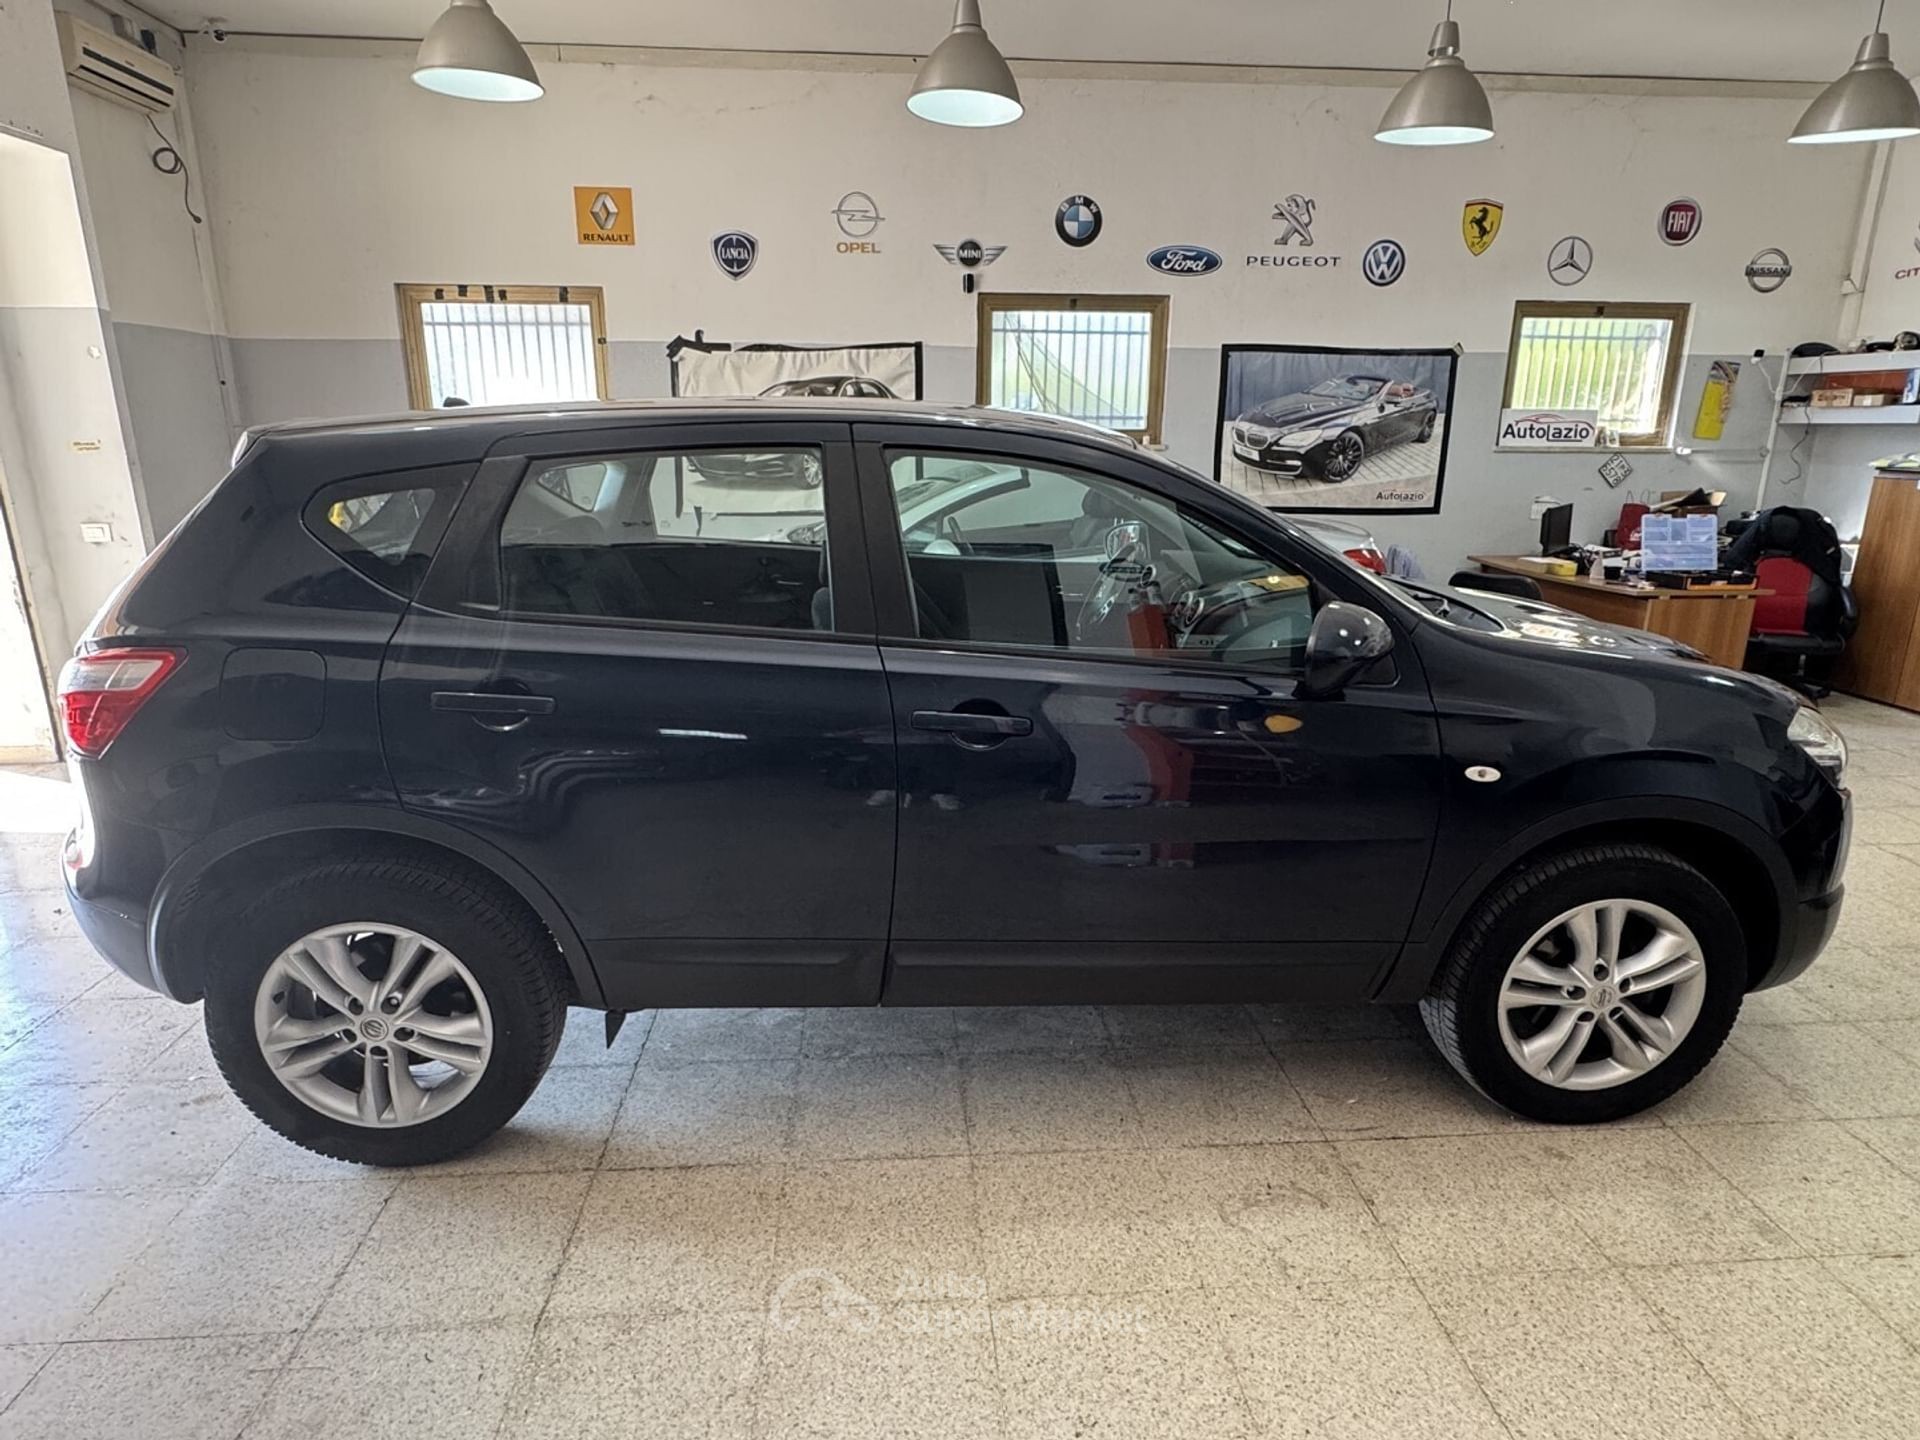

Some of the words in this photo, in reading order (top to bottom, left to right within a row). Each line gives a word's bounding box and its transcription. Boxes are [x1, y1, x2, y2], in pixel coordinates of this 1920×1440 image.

[1060, 196, 1099, 212] BMW
[1667, 210, 1694, 233] FIAT
[583, 232, 631, 243] RENAULT
[720, 247, 750, 260] LANCIA
[836, 241, 882, 254] OPEL
[958, 249, 983, 259] MINI
[1161, 250, 1206, 272] Ford
[1246, 255, 1342, 268] PEUGEOT
[1749, 266, 1788, 276] NISSAN
